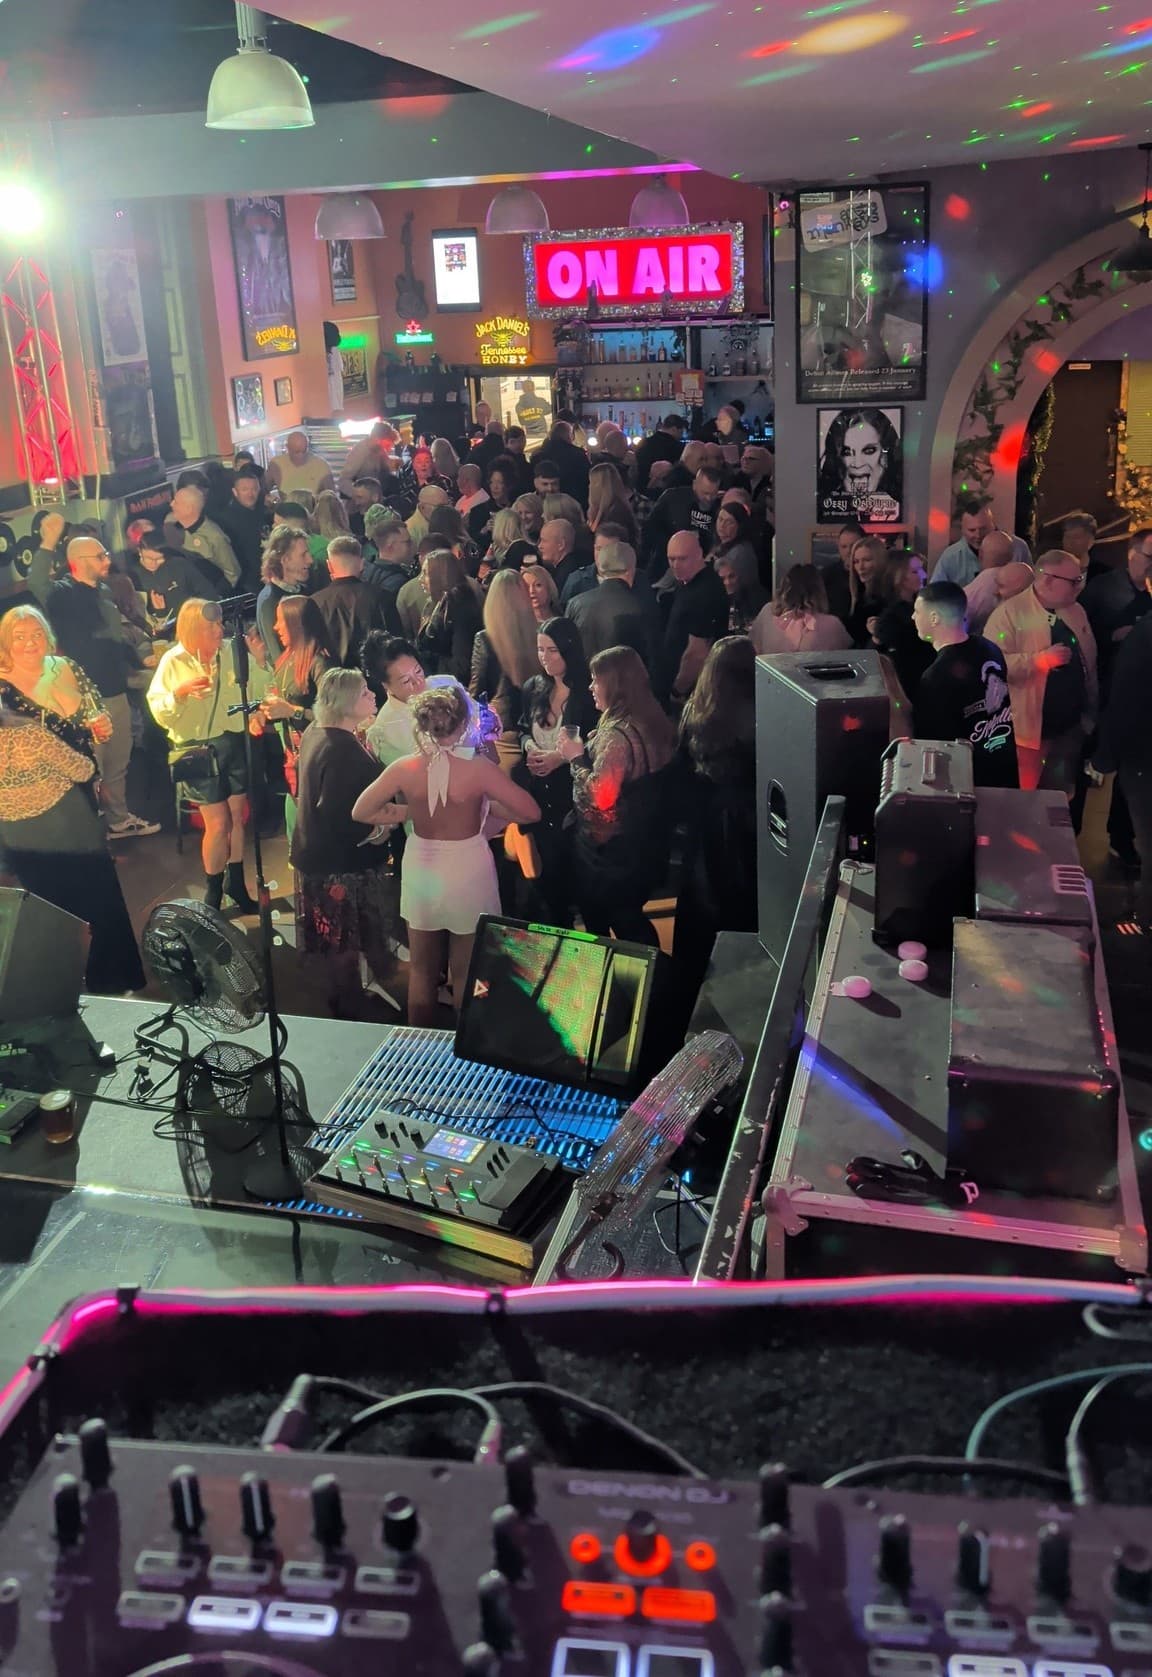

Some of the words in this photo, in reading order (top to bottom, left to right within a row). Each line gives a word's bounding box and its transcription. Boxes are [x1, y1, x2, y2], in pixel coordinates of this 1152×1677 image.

[547, 249, 620, 300] ON
[632, 244, 722, 295] AIR
[475, 319, 497, 338] JACK
[496, 316, 530, 337] DANIEL'S
[480, 343, 527, 356] Tennessee
[482, 355, 527, 365] HONEY
[823, 498, 848, 512] Ozzy
[686, 1486, 729, 1504] DJ
